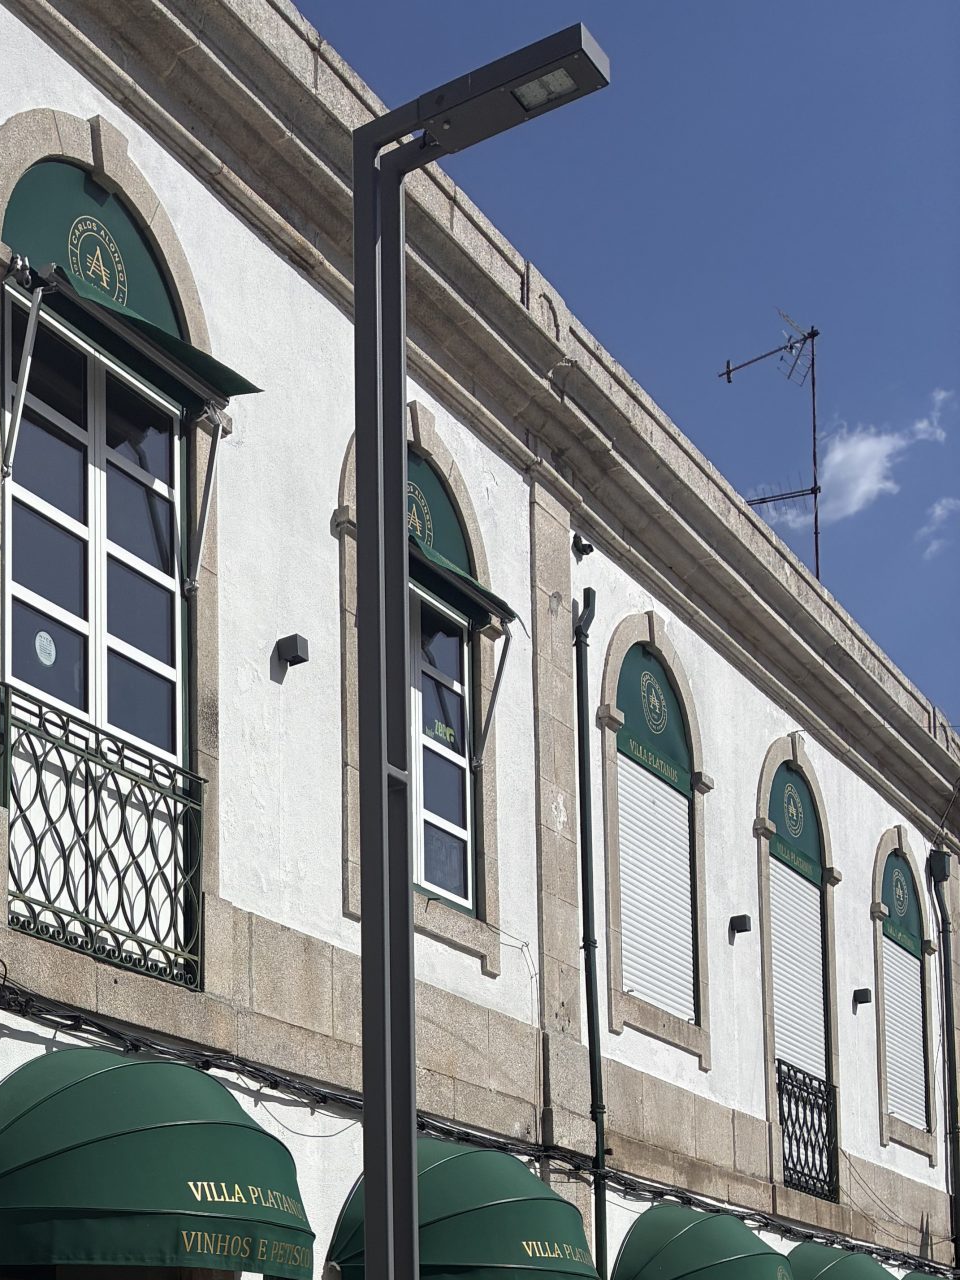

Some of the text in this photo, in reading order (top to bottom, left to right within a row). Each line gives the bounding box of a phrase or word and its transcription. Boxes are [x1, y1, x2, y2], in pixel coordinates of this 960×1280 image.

[72, 221, 125, 281] CARLOS ALONSO
[187, 1181, 247, 1204] VILLA
[180, 1230, 252, 1258] VINHOS
[257, 1239, 269, 1261] E
[521, 1241, 563, 1258] VILLA
